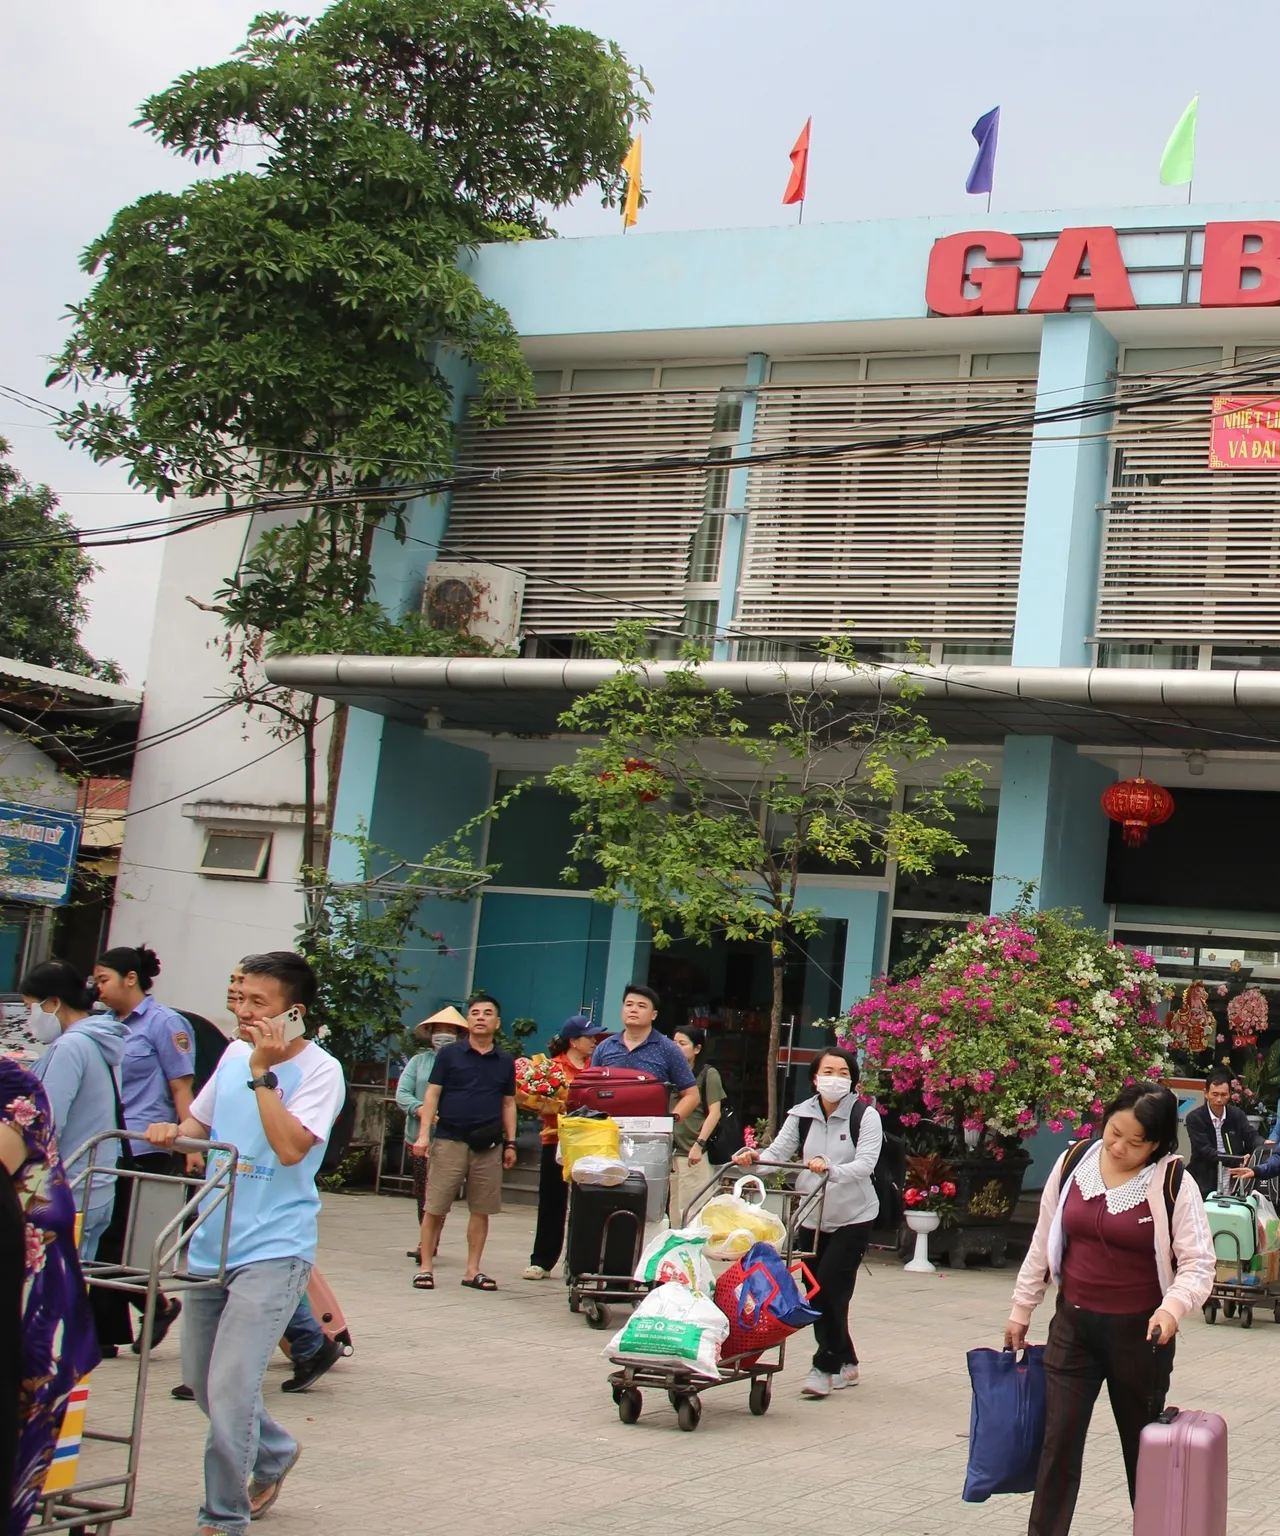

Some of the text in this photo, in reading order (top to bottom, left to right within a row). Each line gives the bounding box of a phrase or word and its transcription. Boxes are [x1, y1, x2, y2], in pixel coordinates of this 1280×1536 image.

[925, 226, 1136, 317] GA
[1223, 406, 1263, 433] NHIỆT
[1229, 435, 1248, 459] VÀ
[1251, 439, 1277, 464] ĐẠI
